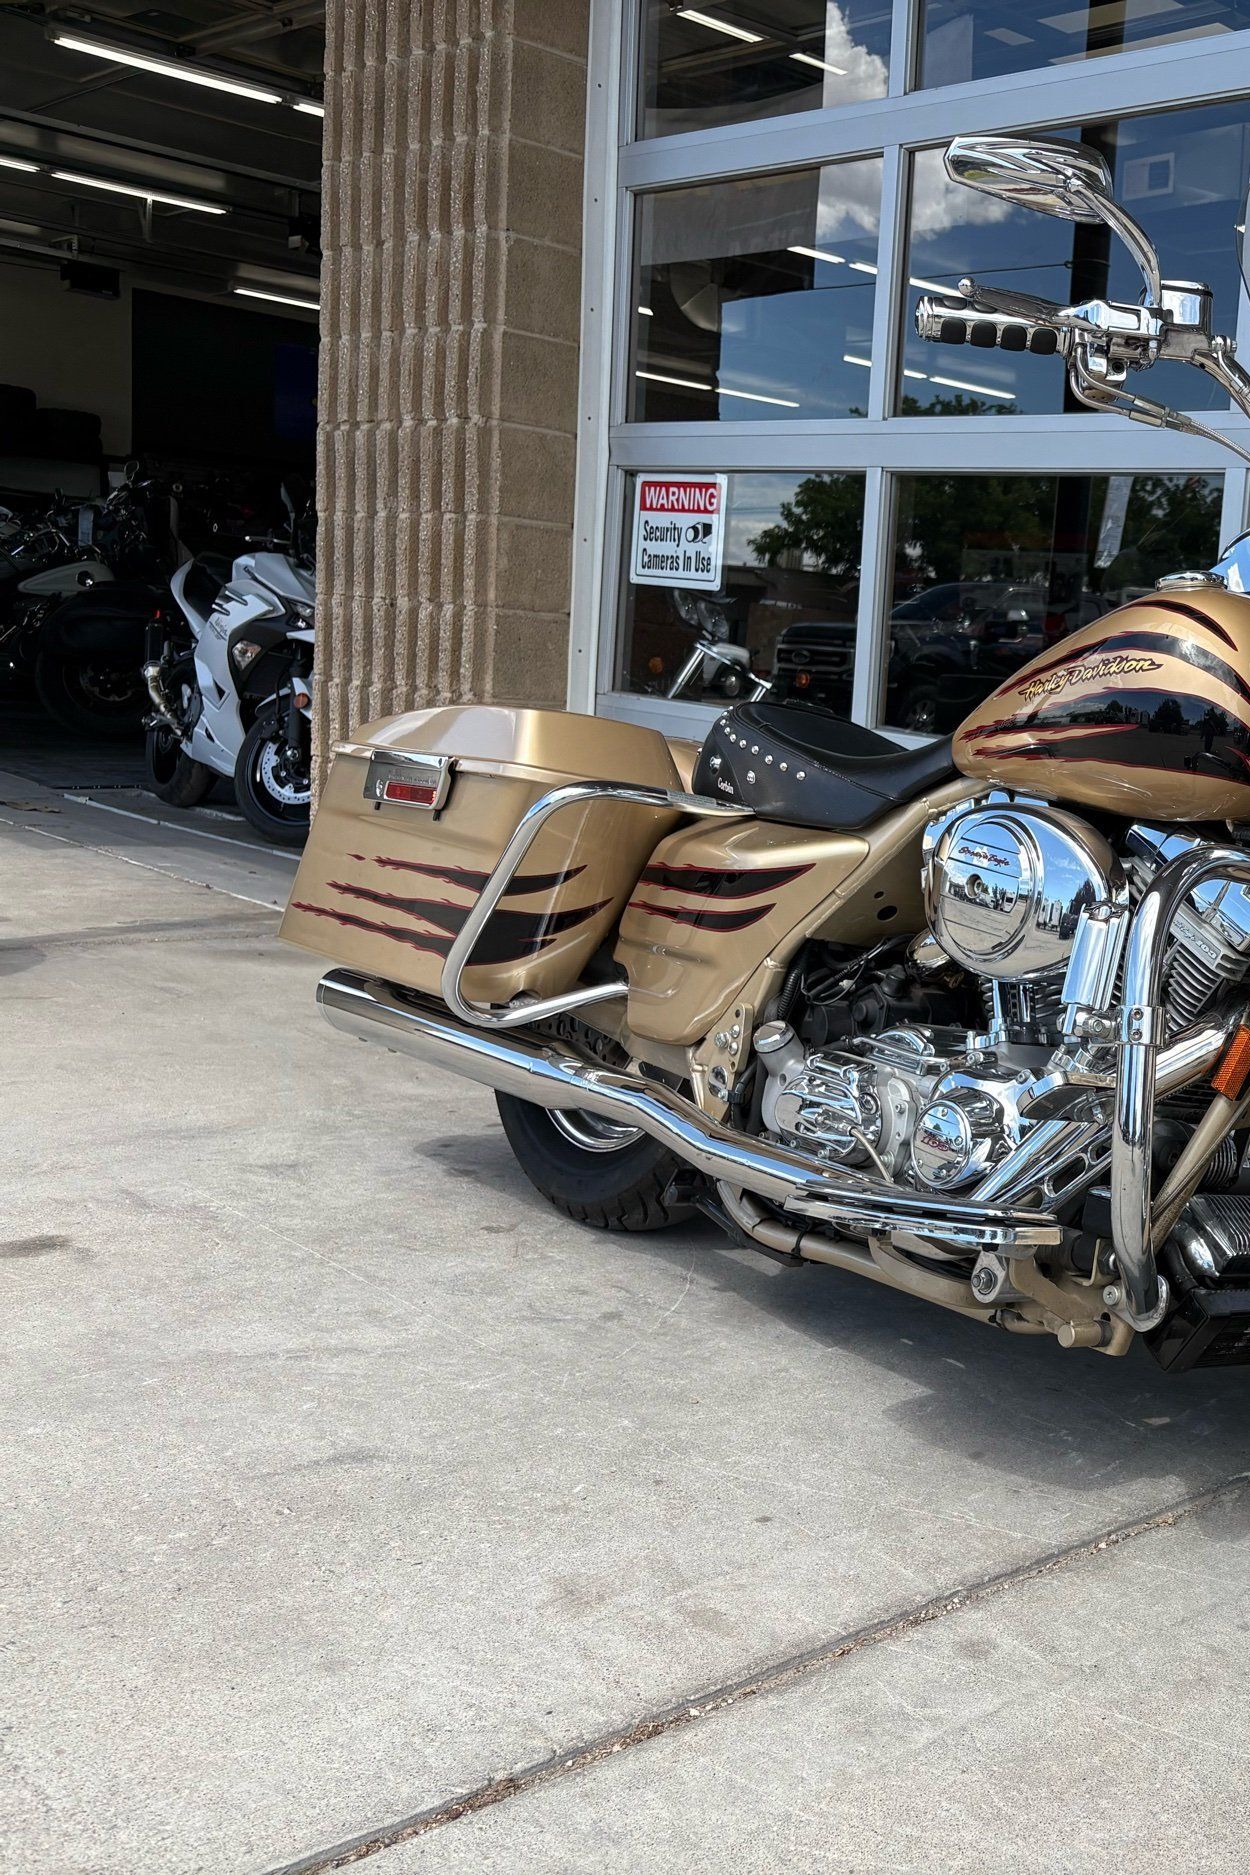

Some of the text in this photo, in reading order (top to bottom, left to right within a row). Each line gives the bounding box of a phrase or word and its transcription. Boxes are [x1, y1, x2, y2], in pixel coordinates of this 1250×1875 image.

[645, 486, 718, 511] WARNING
[643, 520, 683, 548] Security
[641, 547, 712, 573] Cameras In Use
